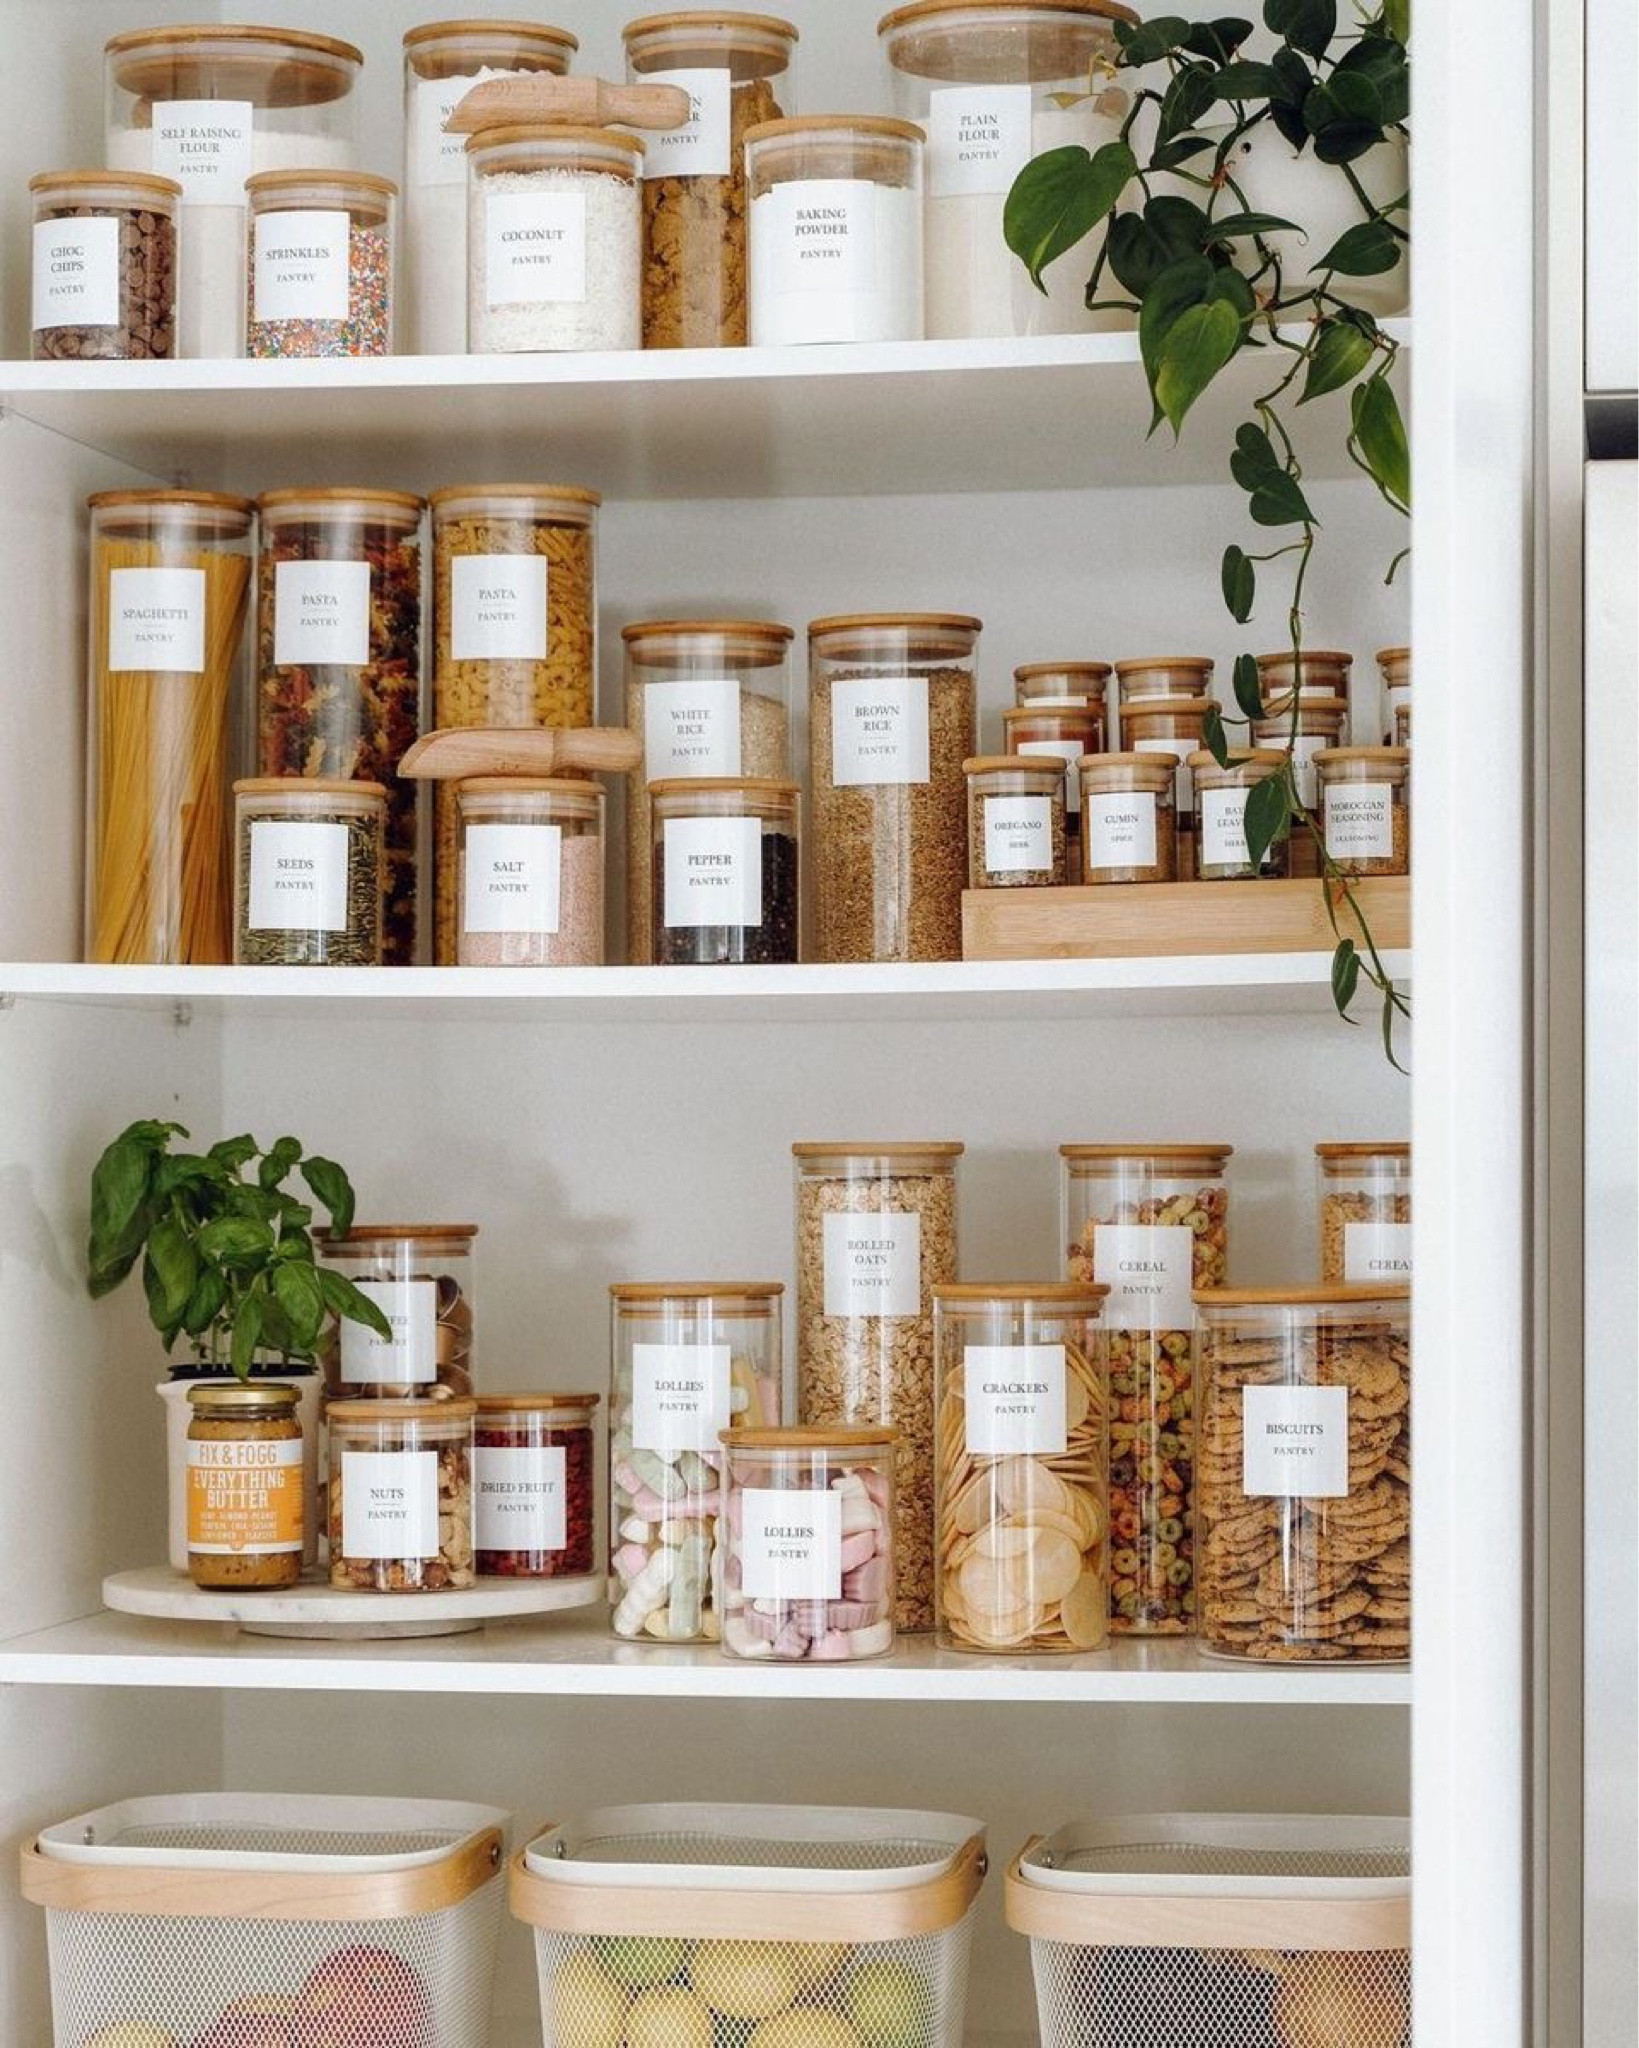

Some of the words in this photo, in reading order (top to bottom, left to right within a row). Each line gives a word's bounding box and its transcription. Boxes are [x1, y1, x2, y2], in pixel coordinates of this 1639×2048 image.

[960, 114, 998, 125] PLAIN
[190, 128, 242, 139] RAISING
[958, 130, 1000, 141] FLOUR
[660, 135, 698, 144] PANTRY
[180, 142, 221, 153] FLOUR
[958, 151, 999, 160] PANTRY
[180, 165, 218, 174] PANTRY
[796, 208, 847, 220] BAKING
[794, 224, 849, 235] POWDER
[501, 230, 565, 241] COCONUT
[50, 245, 84, 258] CHOC
[265, 247, 330, 260] SPRINKLES
[800, 249, 842, 258] PANTRY
[511, 256, 551, 265] PANTRY
[50, 261, 84, 272] CHIPS
[276, 272, 314, 282] PANTRY
[49, 284, 85, 294] PANTRY
[478, 588, 517, 599] PASTA
[301, 594, 338, 605] PASTA
[122, 609, 189, 620] SPAGHETTI
[477, 612, 515, 621] PANTRY
[300, 618, 338, 626] PANTRY
[135, 632, 175, 642] PANTRY
[670, 710, 710, 720] WHITE
[855, 705, 900, 717] BROWN
[675, 724, 706, 734] RICE
[863, 721, 892, 731] RICE
[671, 747, 710, 757] PANTRY
[858, 745, 898, 755] PANTRY
[1330, 801, 1385, 811] MOROCCAN
[1105, 813, 1139, 824] CUMIN
[1330, 812, 1385, 823] SEASONING
[994, 820, 1042, 830] OREGANO
[277, 859, 315, 869] SEEDS
[688, 854, 732, 866] PEPPER
[492, 861, 525, 872] SALT
[275, 881, 314, 890] PANTRY
[688, 877, 731, 886] PANTRY
[488, 883, 529, 893] PANTRY
[847, 1240, 896, 1250] ROLLED
[854, 1254, 887, 1265] OATS
[1119, 1261, 1168, 1272] CEREAL
[852, 1278, 891, 1287] PANTRY
[1122, 1286, 1162, 1295] PANTRY
[655, 1380, 704, 1391] LOLLIES
[982, 1383, 1049, 1394] CRACKERS
[659, 1402, 699, 1411] PANTRY
[995, 1405, 1036, 1414] PANTRY
[1266, 1423, 1324, 1435] BISCUITS
[199, 1443, 218, 1464] FIX
[222, 1443, 233, 1465] &
[236, 1443, 277, 1464] FOGG
[1273, 1446, 1316, 1456] PANTRY
[193, 1468, 286, 1489] EVERYTHING
[480, 1482, 515, 1493] DRIED
[517, 1482, 555, 1493] FRUIT
[370, 1488, 404, 1499] NUTS
[207, 1489, 268, 1509] BUTTER
[497, 1503, 535, 1512] PANTRY
[368, 1510, 407, 1520] PANTRY
[764, 1526, 814, 1538] LOLLIES
[768, 1549, 809, 1559] PANTRY
